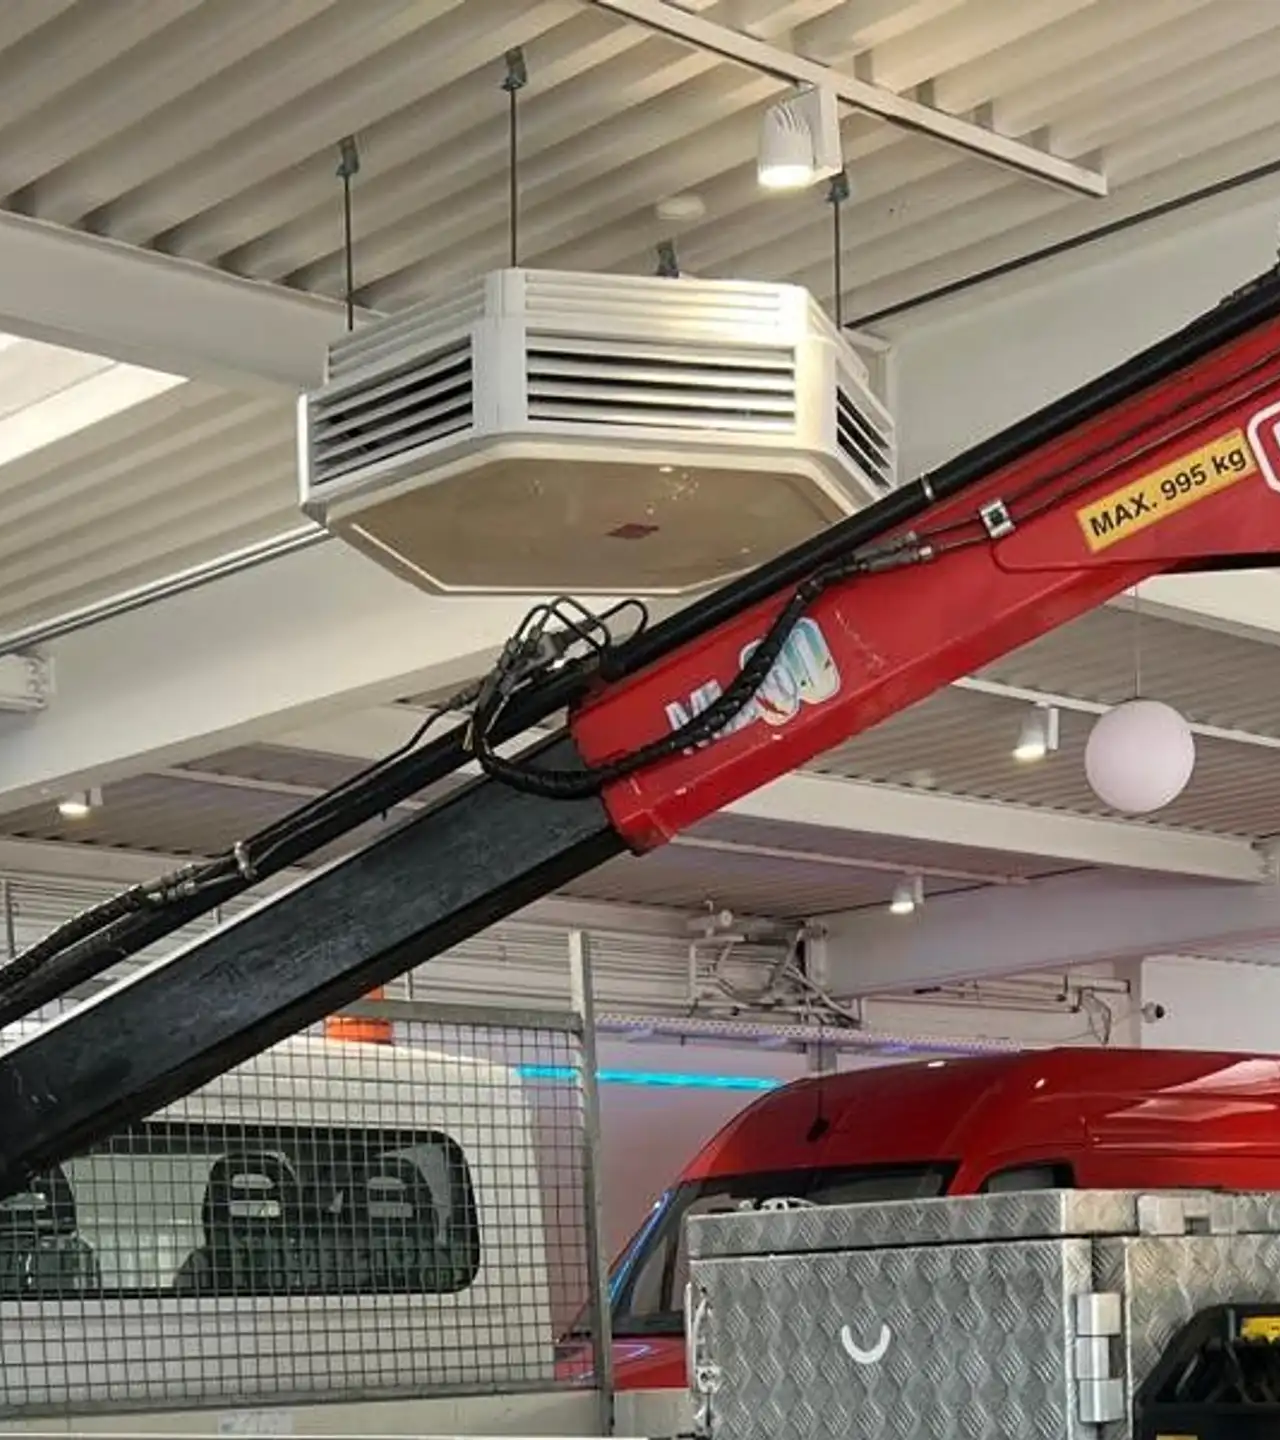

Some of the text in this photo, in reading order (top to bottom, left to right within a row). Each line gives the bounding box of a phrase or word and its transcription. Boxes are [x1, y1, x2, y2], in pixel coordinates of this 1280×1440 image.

[1088, 444, 1248, 537] MAX. 995 kg
